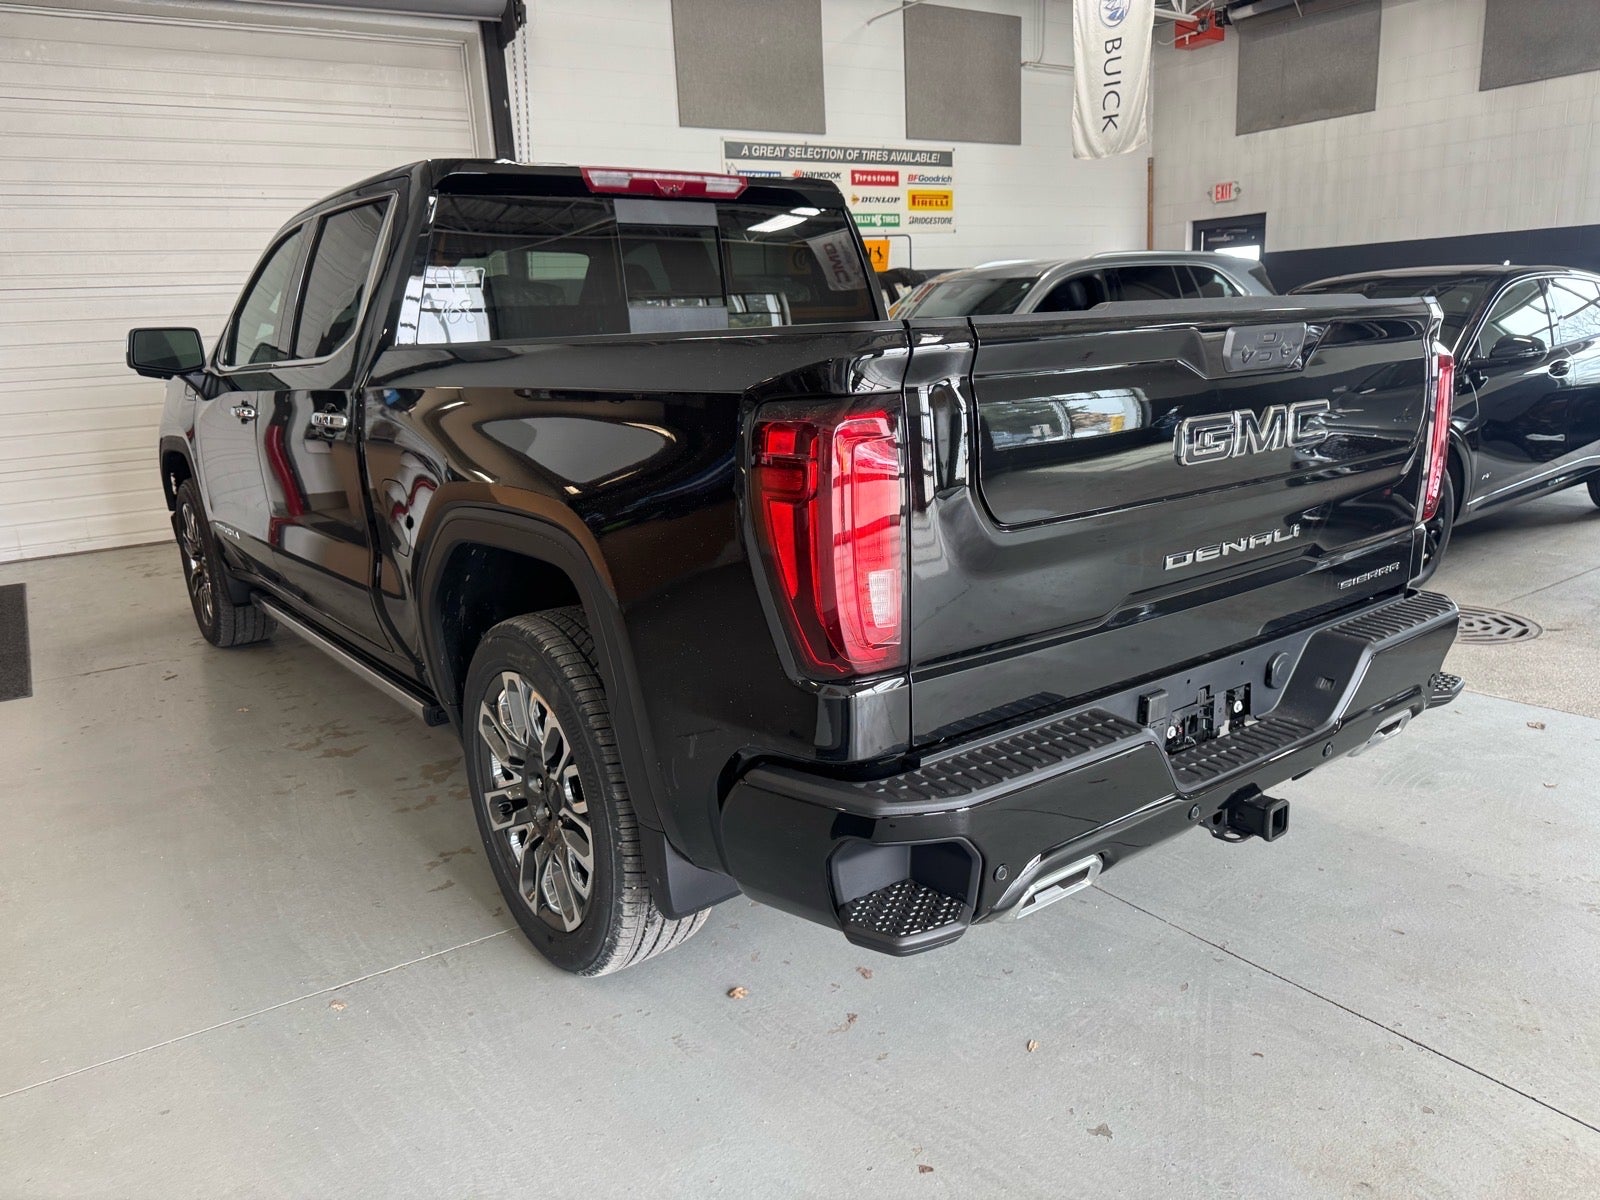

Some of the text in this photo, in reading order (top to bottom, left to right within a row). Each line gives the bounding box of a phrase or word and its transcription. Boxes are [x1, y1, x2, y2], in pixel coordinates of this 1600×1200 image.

[1102, 37, 1122, 133] BUICK
[741, 145, 940, 163] A GREAT SELECTION OF TIRES AVAILABLE!
[854, 173, 896, 183] Firestone
[907, 173, 952, 183] BFGoodrich
[1215, 183, 1233, 201] EXIT
[861, 196, 900, 204] DUNLOP
[912, 194, 949, 206] PIRELLI
[882, 215, 899, 224] TIRES
[908, 216, 952, 225] BRIDGESTONE
[1173, 399, 1331, 466] GMC
[1163, 523, 1301, 571] DENALI
[1337, 561, 1401, 590] SIERRA
